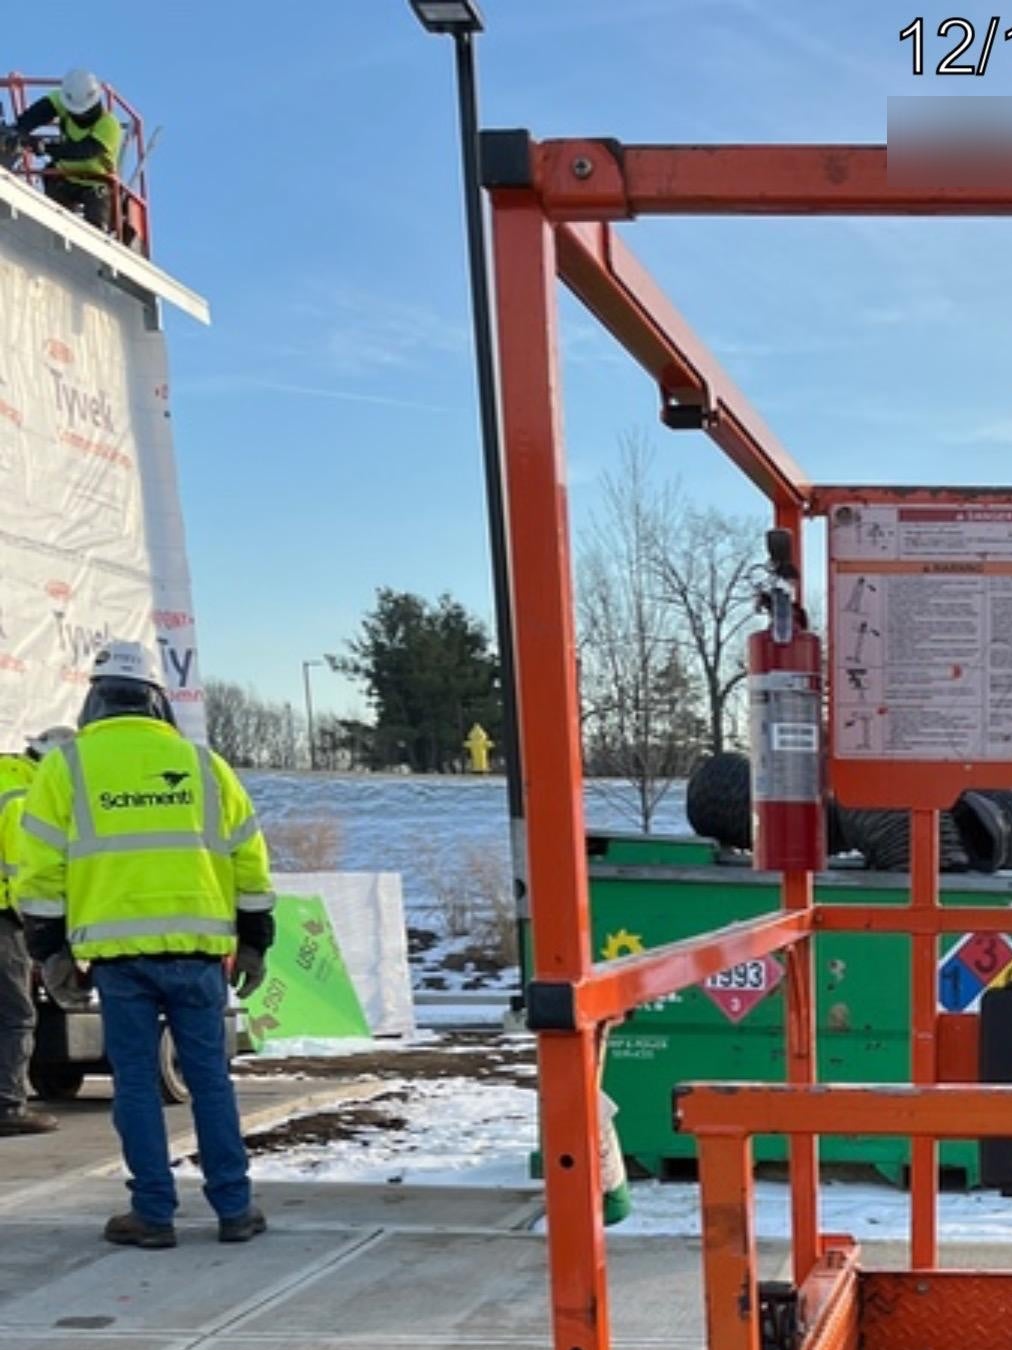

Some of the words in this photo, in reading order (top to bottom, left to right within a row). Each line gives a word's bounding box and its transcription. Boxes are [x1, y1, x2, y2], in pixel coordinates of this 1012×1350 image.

[44, 361, 115, 433] Tyvek
[52, 606, 109, 666] Tyve
[100, 788, 193, 810] Schimenti
[974, 935, 998, 973] 3
[730, 997, 742, 1013] 3
